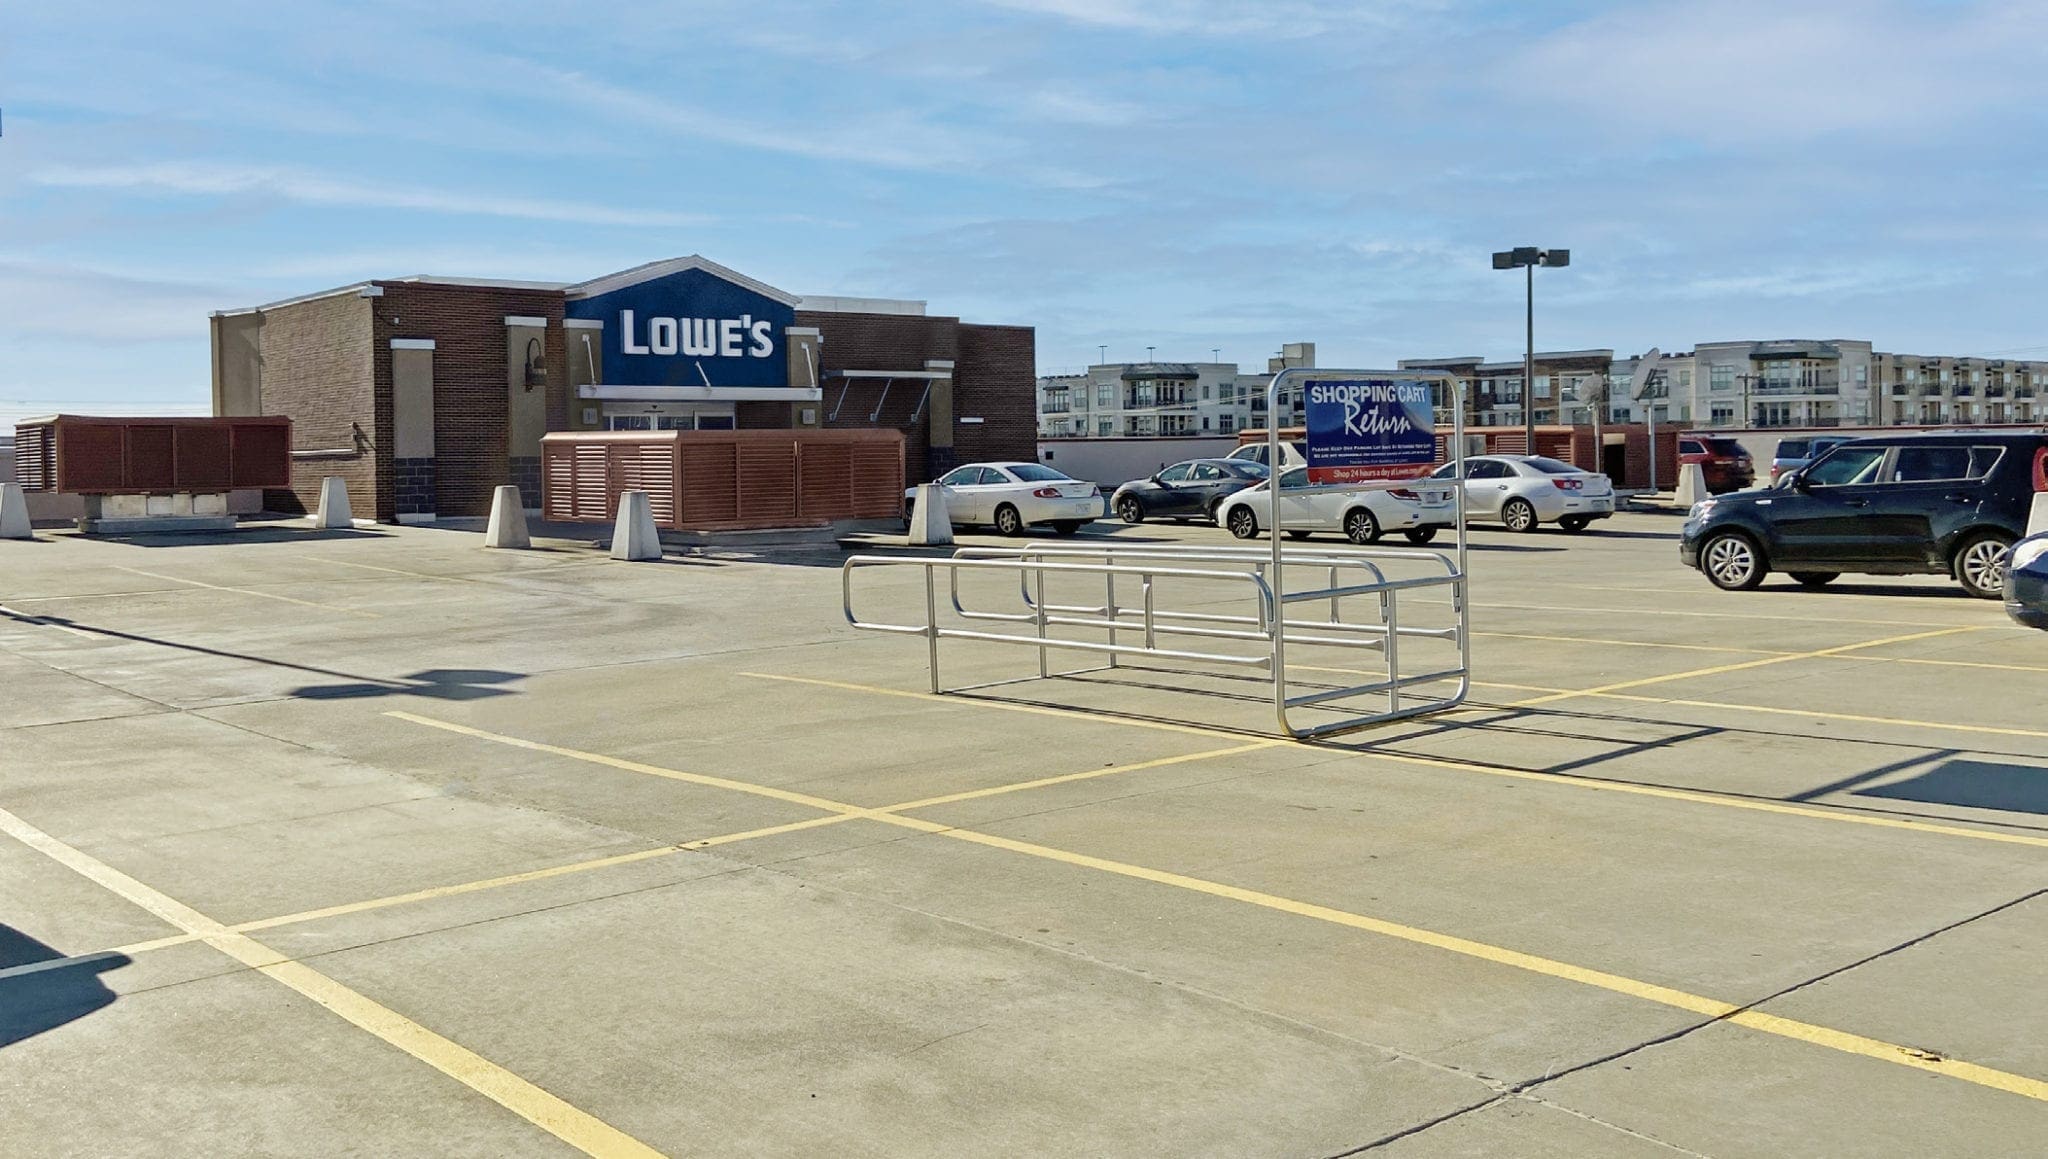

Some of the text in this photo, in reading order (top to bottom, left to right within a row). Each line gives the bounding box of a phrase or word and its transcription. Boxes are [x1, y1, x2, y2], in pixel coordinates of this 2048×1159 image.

[620, 309, 774, 358] LOWE'S
[1311, 386, 1426, 403] SHOPPING CART
[1344, 400, 1411, 436] Return
[1333, 469, 1350, 479] Shop
[1350, 469, 1359, 478] 24
[1359, 468, 1376, 477] hours
[1381, 467, 1390, 477] day
